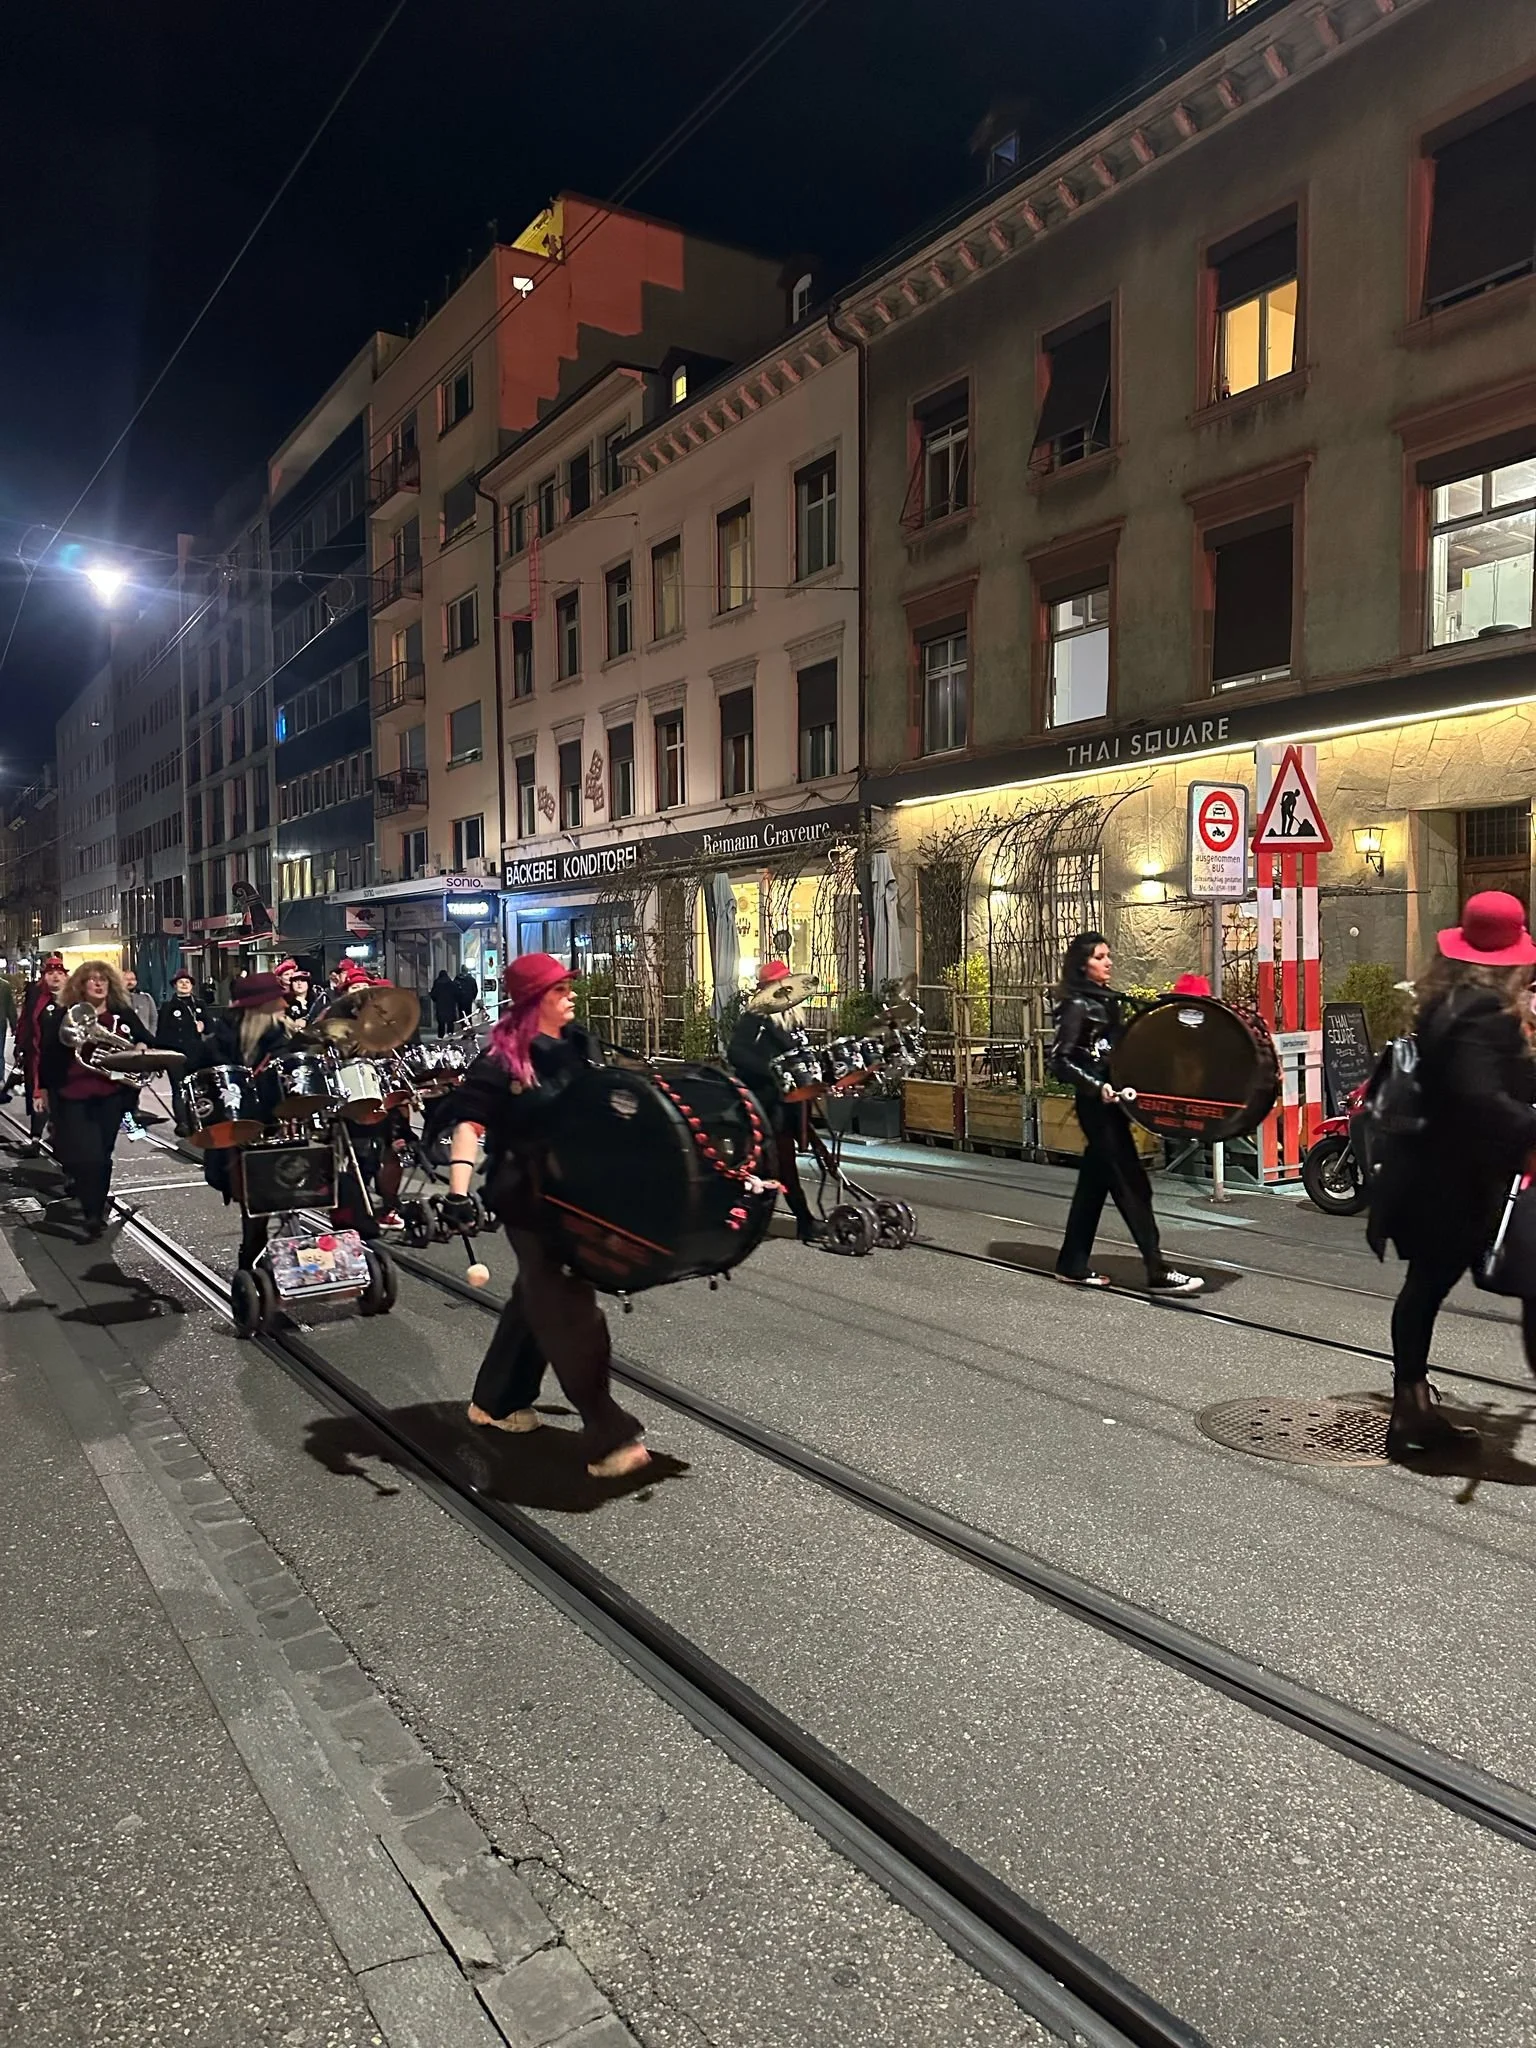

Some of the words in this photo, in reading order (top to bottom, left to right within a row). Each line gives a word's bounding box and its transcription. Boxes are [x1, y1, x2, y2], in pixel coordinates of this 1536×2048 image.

[1067, 738, 1119, 766] THAI
[1130, 717, 1229, 756] SQUARE
[703, 832, 759, 855] Reimann
[763, 822, 830, 847] Graveure
[506, 859, 557, 886] BÄCKEREI
[563, 845, 637, 879] KONDITOREI
[1196, 855, 1240, 865] ausgenommen
[1212, 864, 1225, 873] BUS
[1327, 1014, 1348, 1029] THAI
[1327, 1028, 1357, 1044] SQUARE
